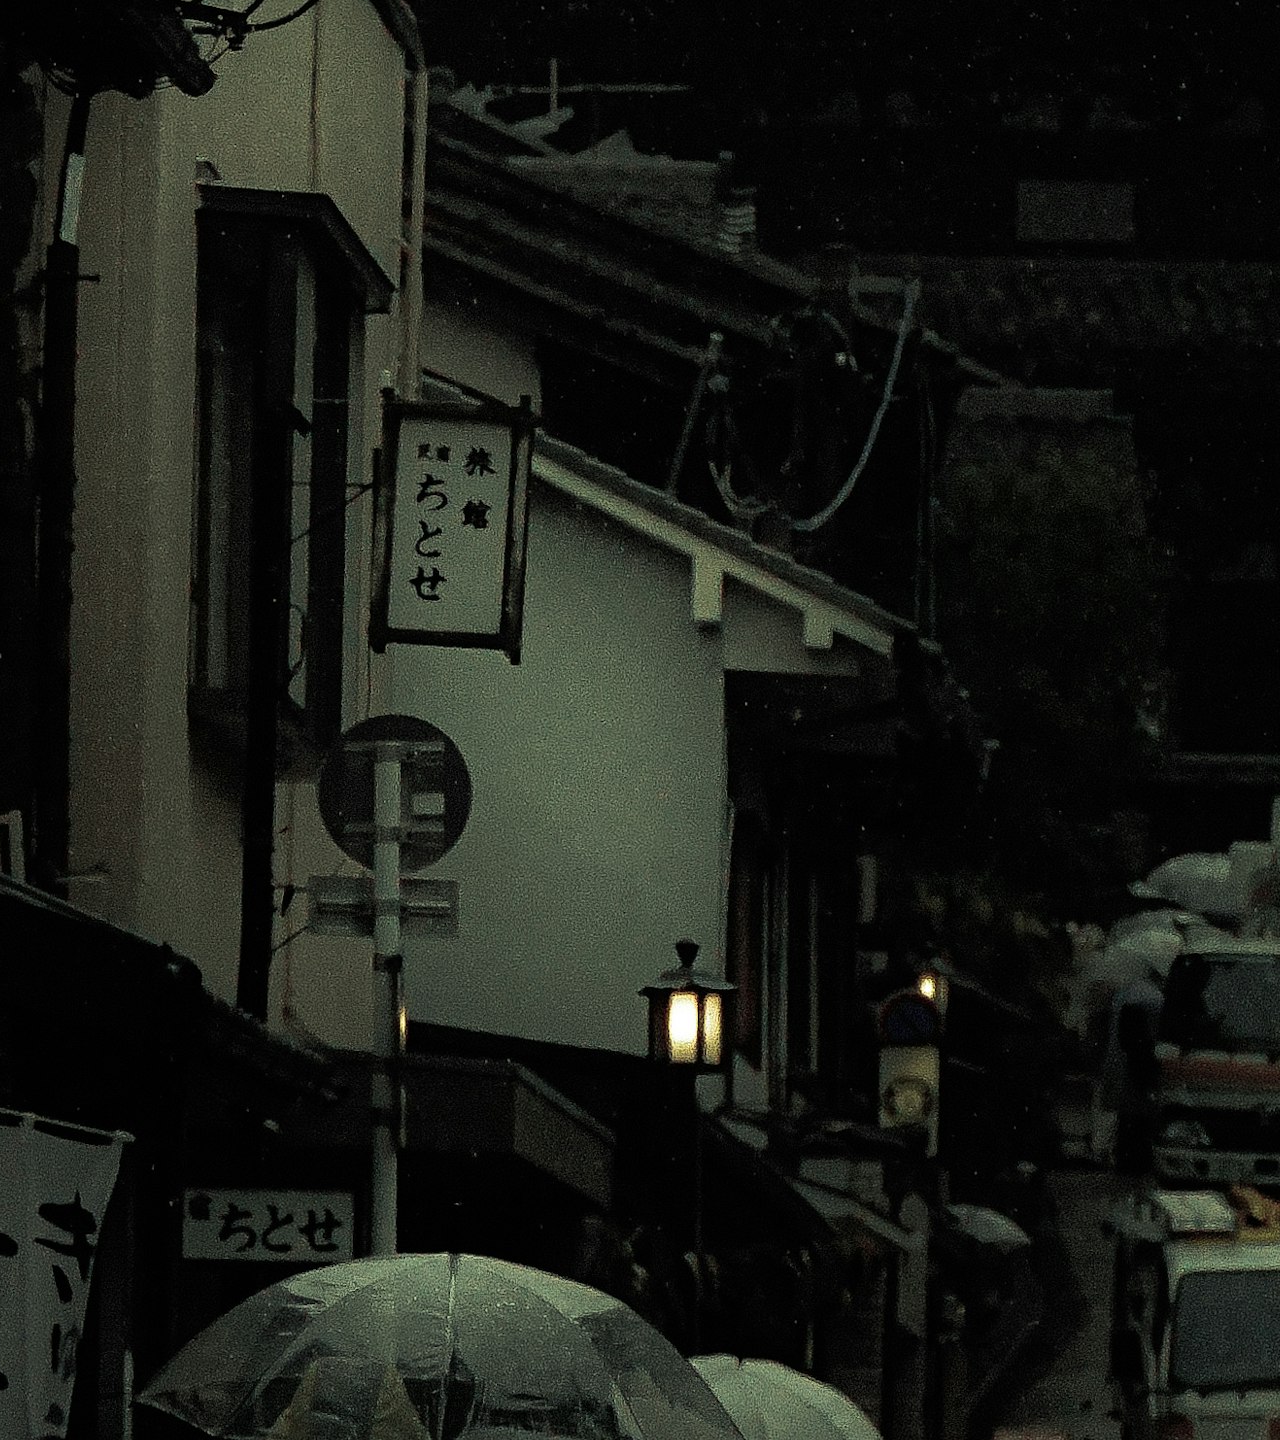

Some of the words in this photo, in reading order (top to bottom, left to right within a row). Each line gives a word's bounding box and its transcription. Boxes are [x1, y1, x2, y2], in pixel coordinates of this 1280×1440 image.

[462, 446, 497, 530] 旅館
[409, 473, 449, 602] ちとせ
[219, 1201, 343, 1254] ちとせ
